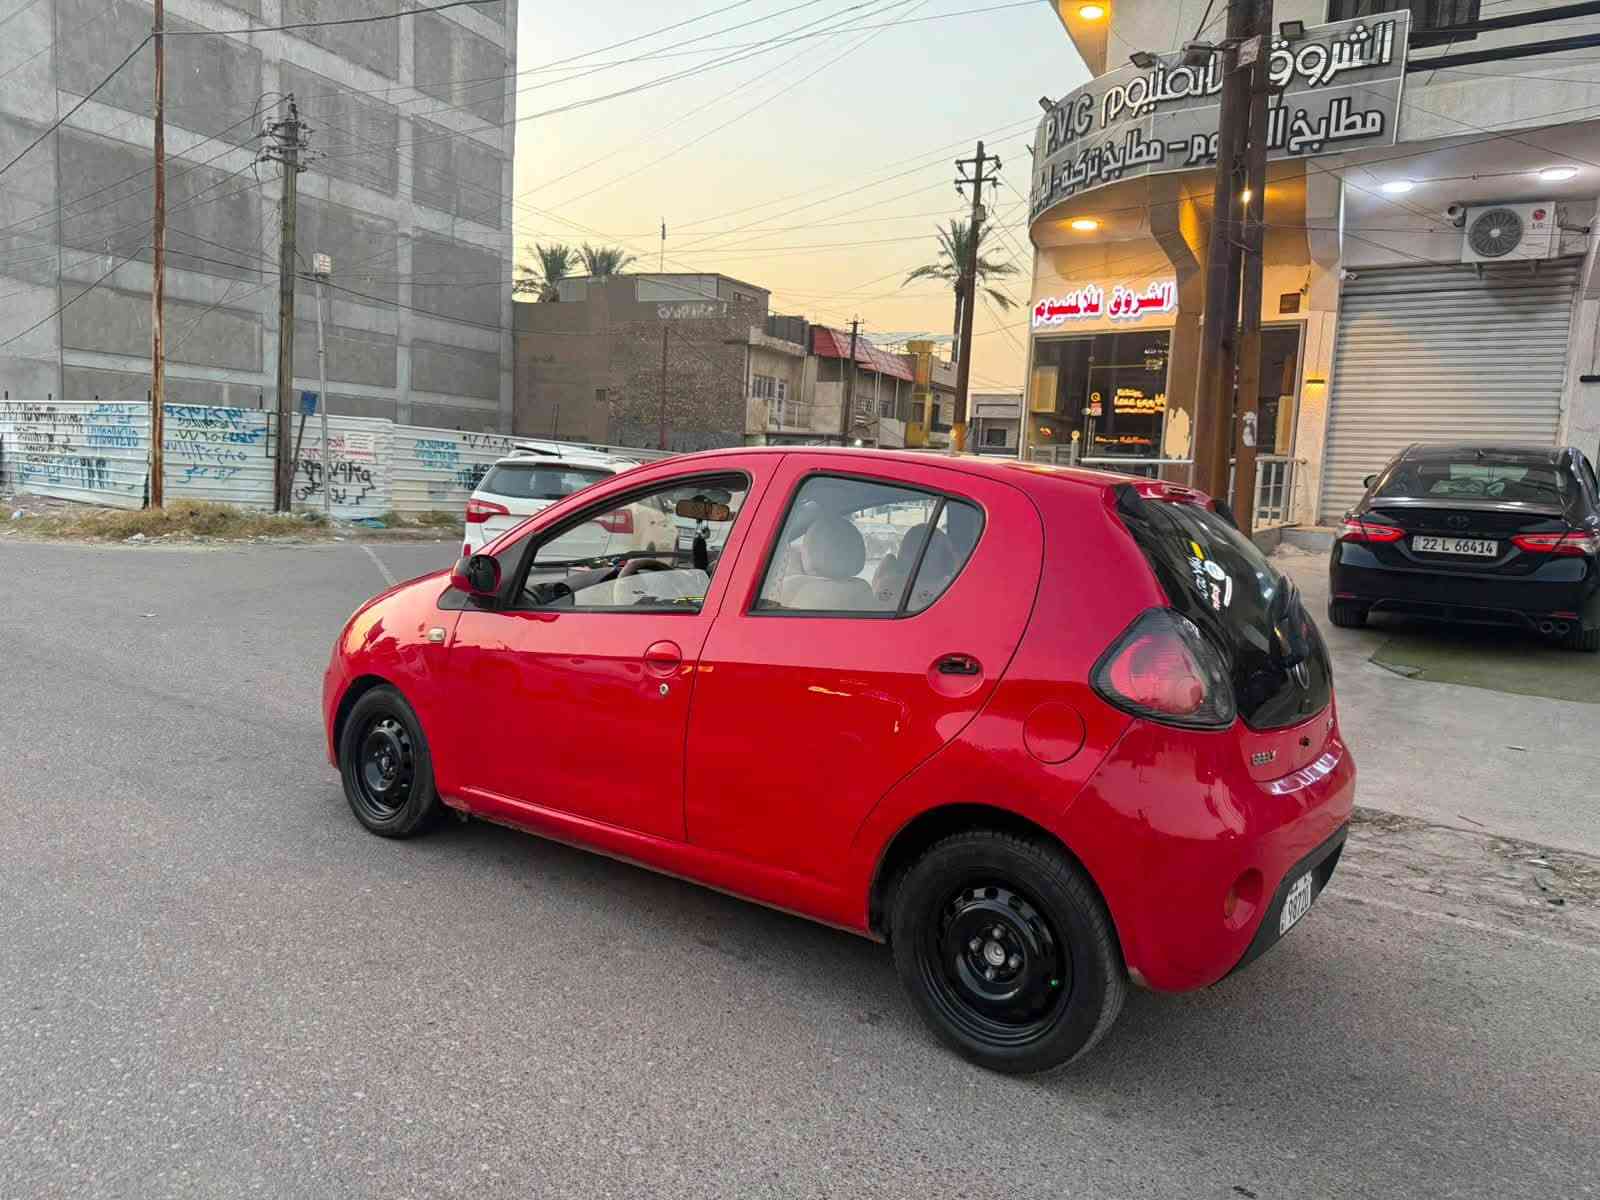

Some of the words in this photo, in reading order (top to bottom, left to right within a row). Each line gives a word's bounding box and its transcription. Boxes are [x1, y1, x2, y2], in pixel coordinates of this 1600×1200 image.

[1269, 20, 1395, 86] الشروق
[1044, 94, 1093, 155] P.V.C
[1289, 98, 1383, 152] مطابخ
[1101, 129, 1163, 180] مطابخ
[1108, 283, 1173, 317] الشروق
[1422, 538, 1438, 551] 22
[1442, 540, 1449, 551] L
[1454, 541, 1494, 554] 66414
